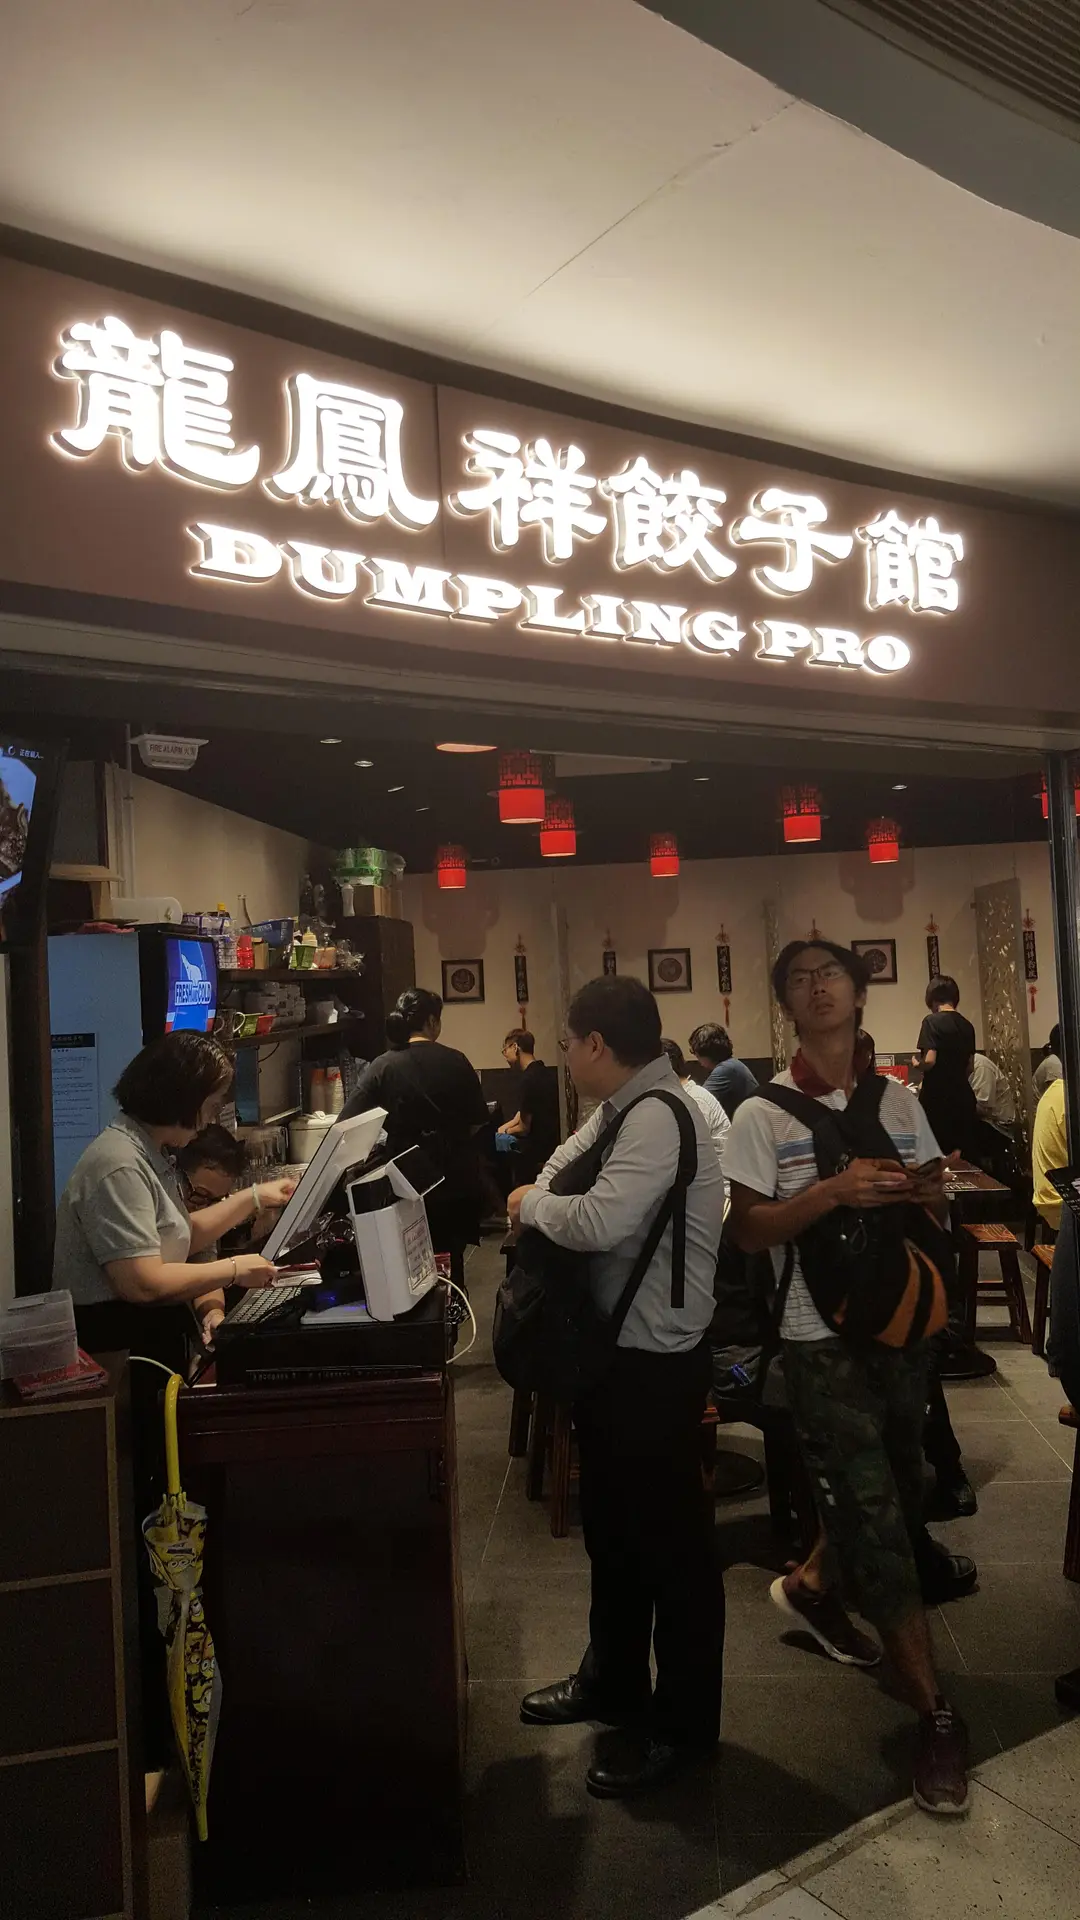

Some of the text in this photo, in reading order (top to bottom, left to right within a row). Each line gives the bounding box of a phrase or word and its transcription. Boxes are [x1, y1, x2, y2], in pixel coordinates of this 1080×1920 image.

[52, 317, 964, 614] 龍鳳祥餃子館
[187, 522, 912, 674] DUMPLING PRO
[149, 744, 162, 753] FIRE
[163, 744, 183, 755] ALARM
[175, 983, 192, 1004] FRESH
[197, 983, 211, 1003] COLD
